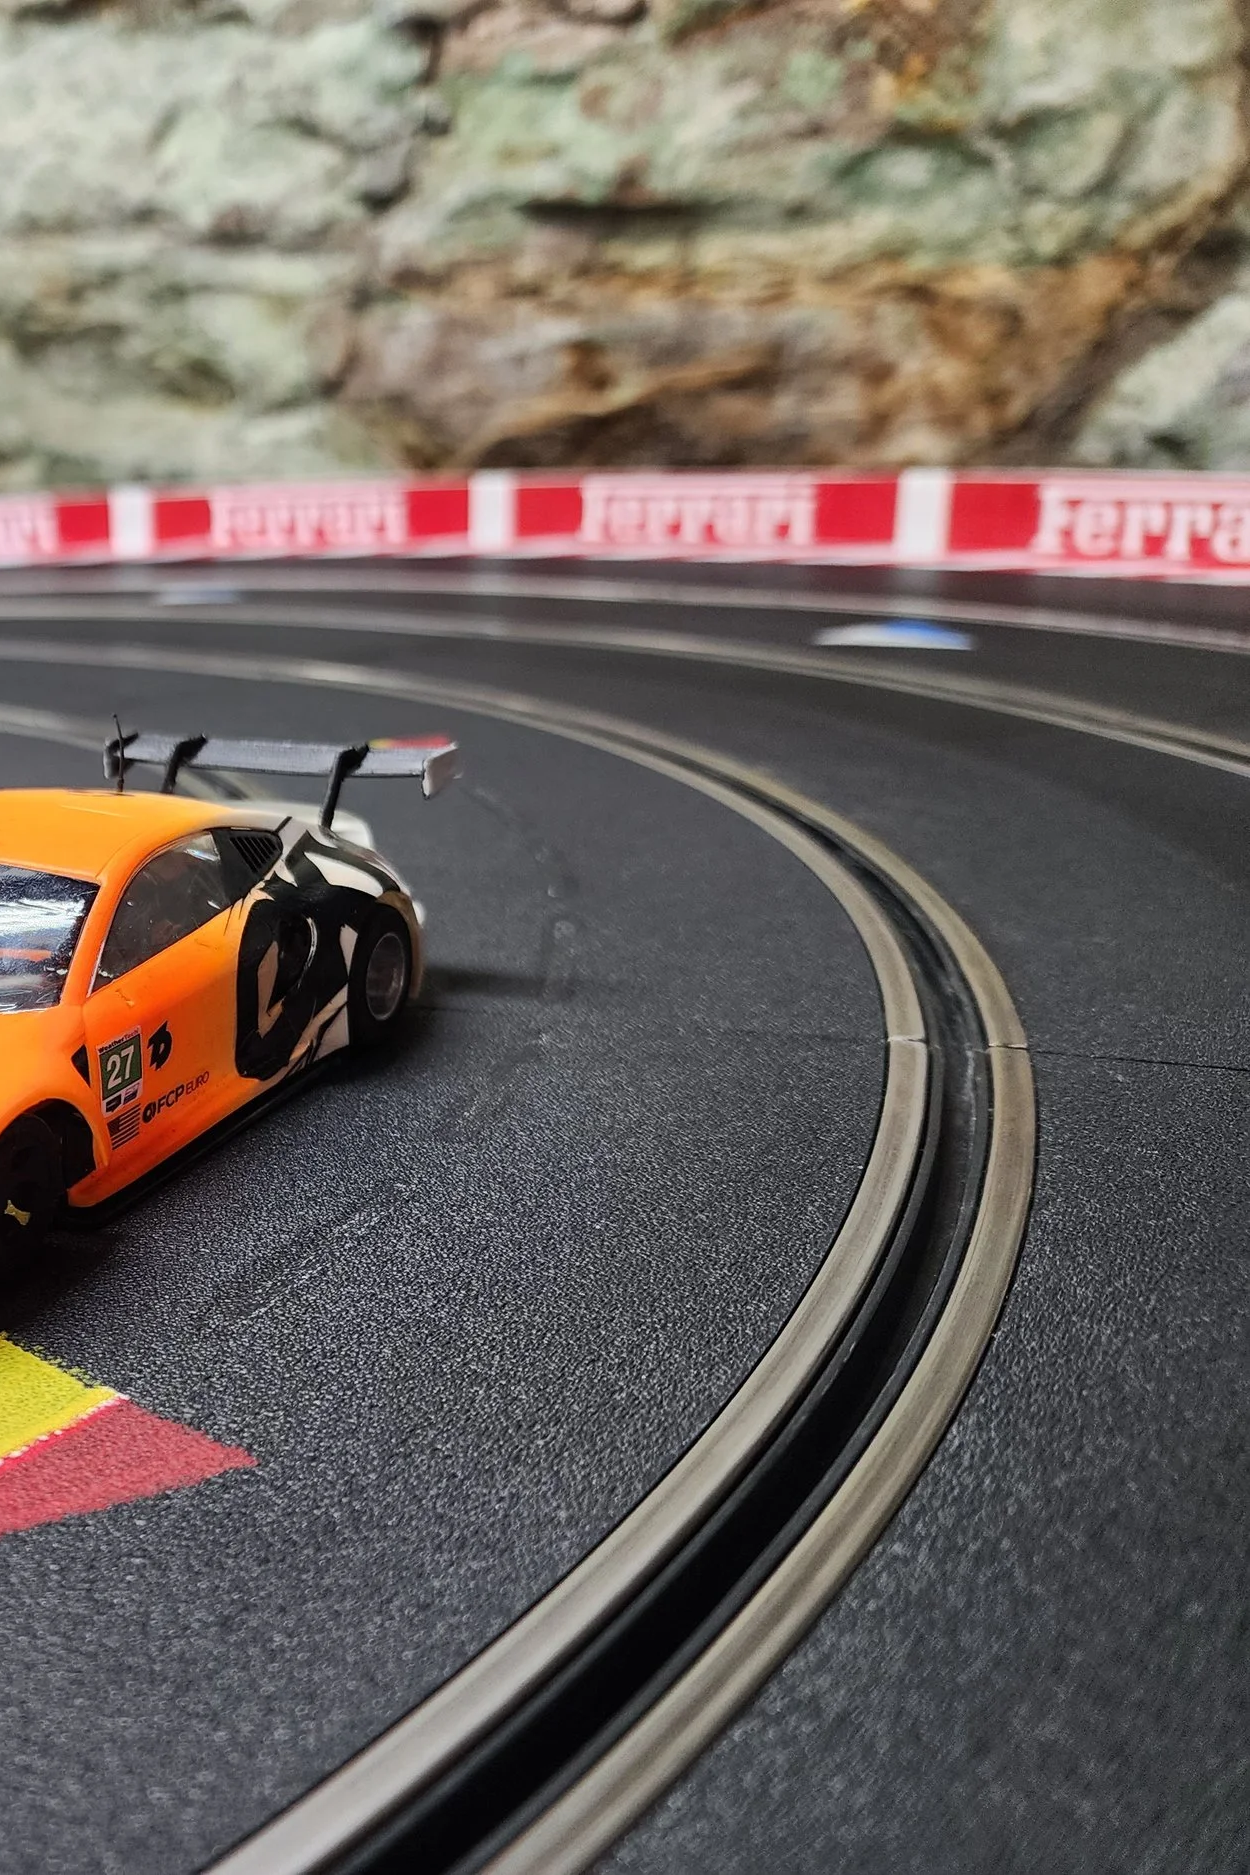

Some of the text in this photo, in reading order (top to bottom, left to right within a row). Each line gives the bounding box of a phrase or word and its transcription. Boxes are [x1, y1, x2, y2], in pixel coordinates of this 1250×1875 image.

[210, 484, 408, 549] Ferrari
[578, 474, 816, 546] Ferrari
[106, 1045, 135, 1090] 27
